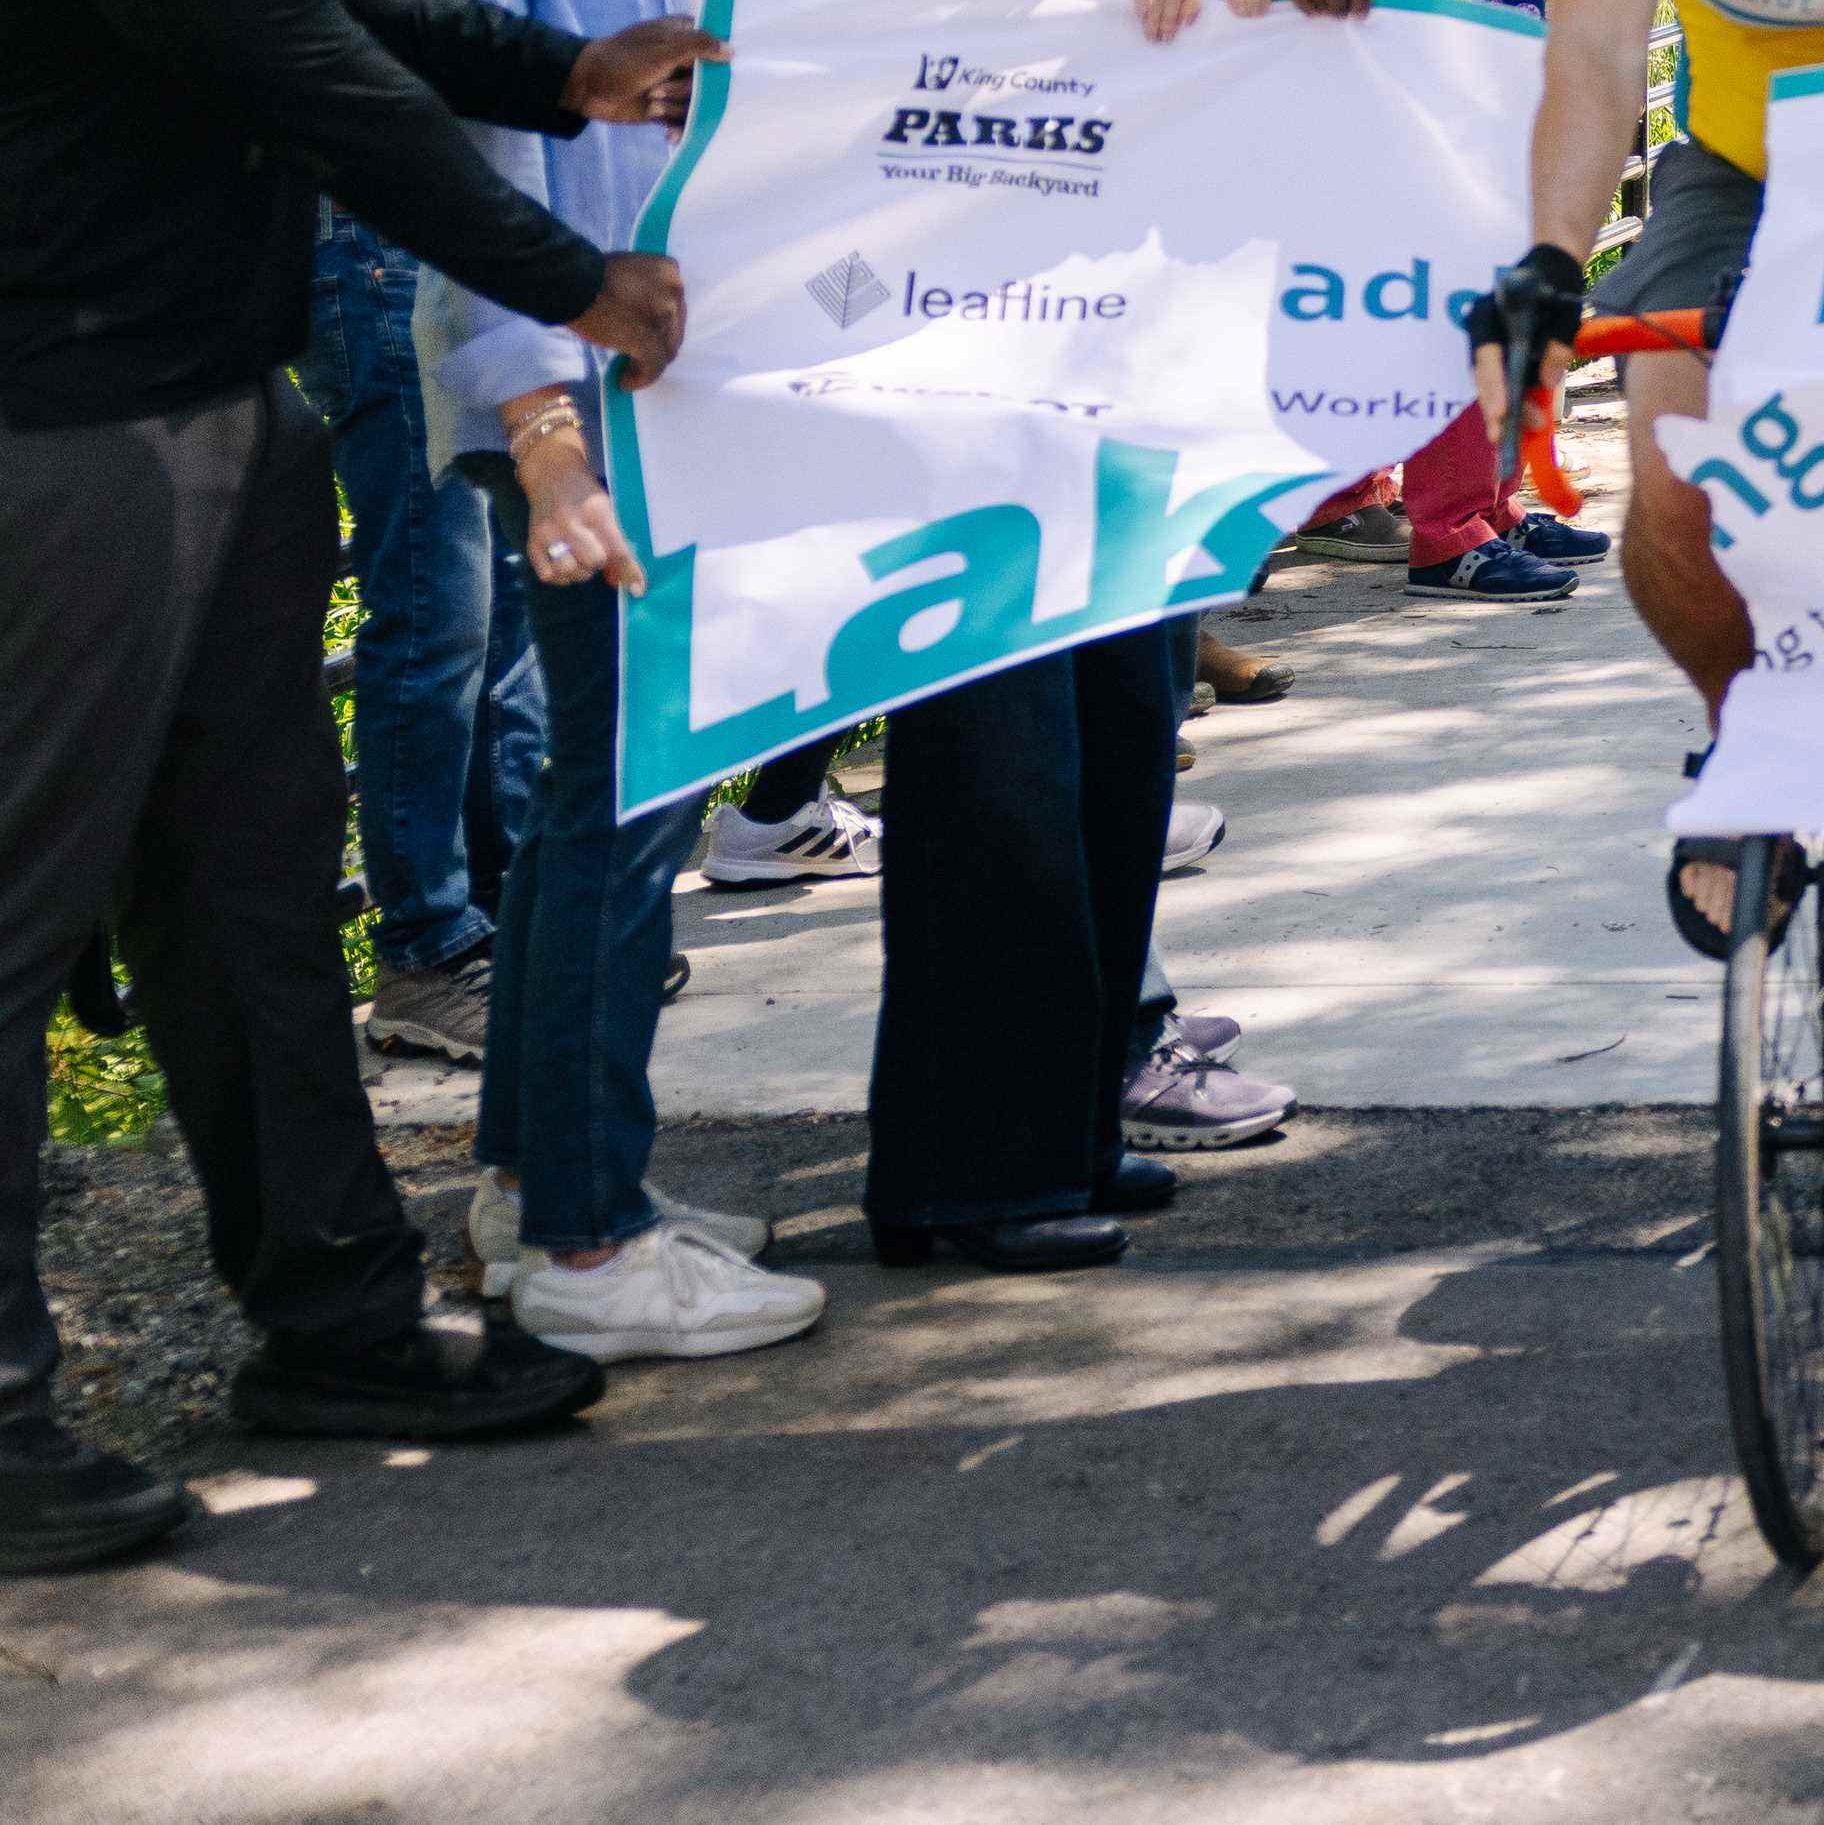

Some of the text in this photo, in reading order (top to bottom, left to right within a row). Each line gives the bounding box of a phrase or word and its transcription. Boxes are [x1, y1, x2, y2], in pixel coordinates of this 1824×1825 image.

[958, 66, 1097, 97] King County
[883, 107, 1113, 155] PARKS
[879, 163, 941, 181] Your
[946, 163, 984, 189] Big
[902, 269, 1128, 322] leafline
